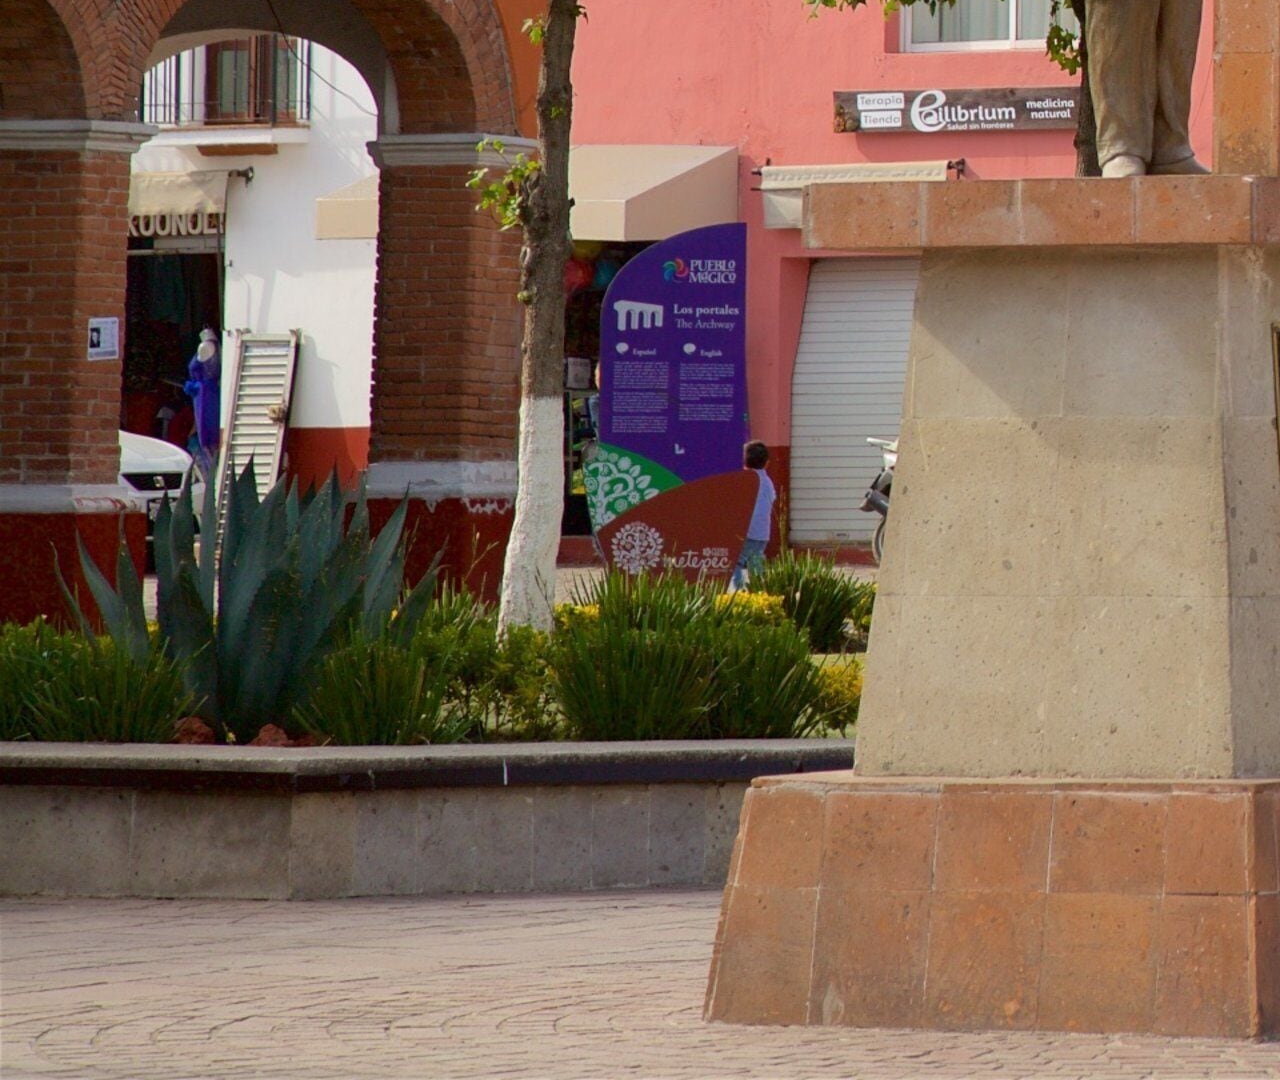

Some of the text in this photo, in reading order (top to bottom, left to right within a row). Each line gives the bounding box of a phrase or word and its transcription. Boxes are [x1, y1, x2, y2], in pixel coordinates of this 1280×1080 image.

[859, 95, 903, 107] Terapia
[1026, 98, 1074, 109] medicina
[1030, 108, 1072, 119] natural
[863, 114, 901, 125] Tienda
[947, 122, 968, 130] Salud
[690, 259, 736, 271] PUEBLO
[673, 304, 740, 318] Los portales
[676, 319, 736, 332] The Archway
